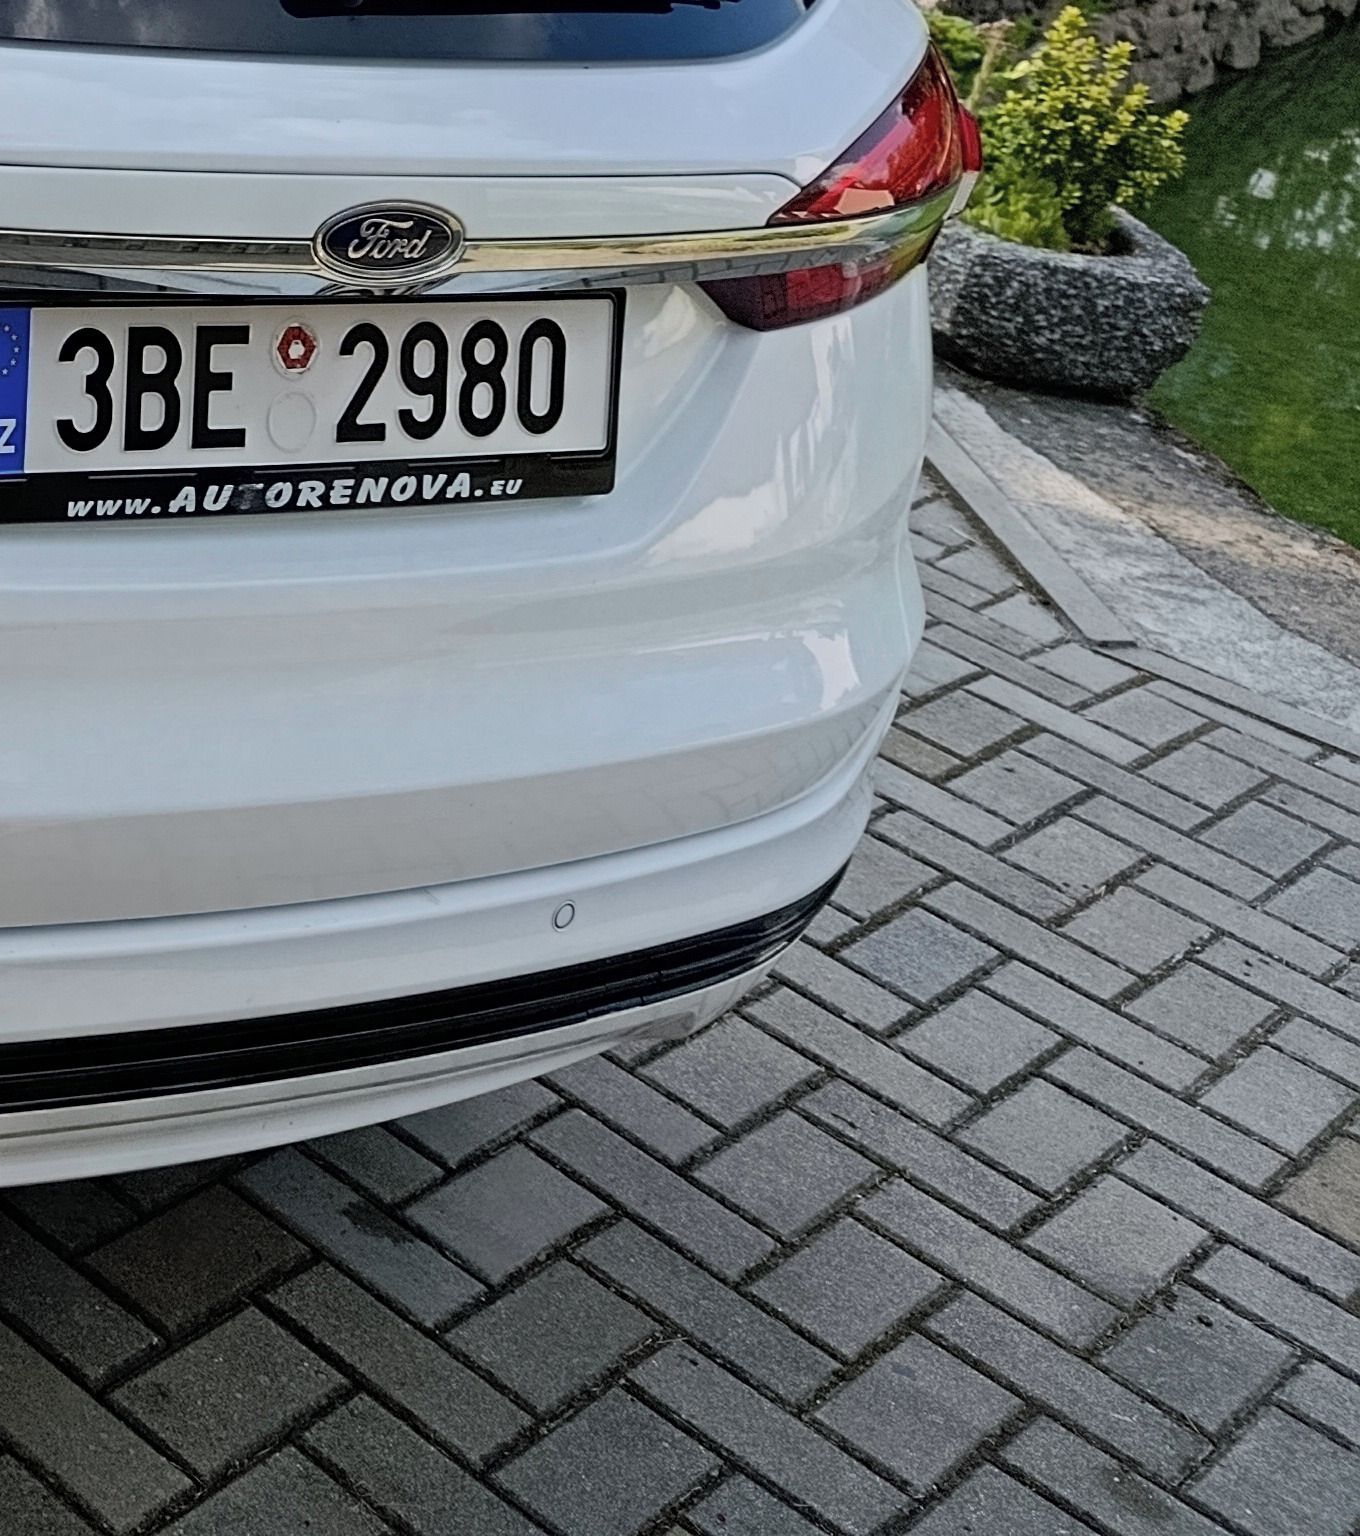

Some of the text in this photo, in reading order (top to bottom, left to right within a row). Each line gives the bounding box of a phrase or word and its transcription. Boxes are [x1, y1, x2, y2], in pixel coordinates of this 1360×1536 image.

[347, 218, 432, 259] Ford
[56, 317, 567, 452] 3BE 2980
